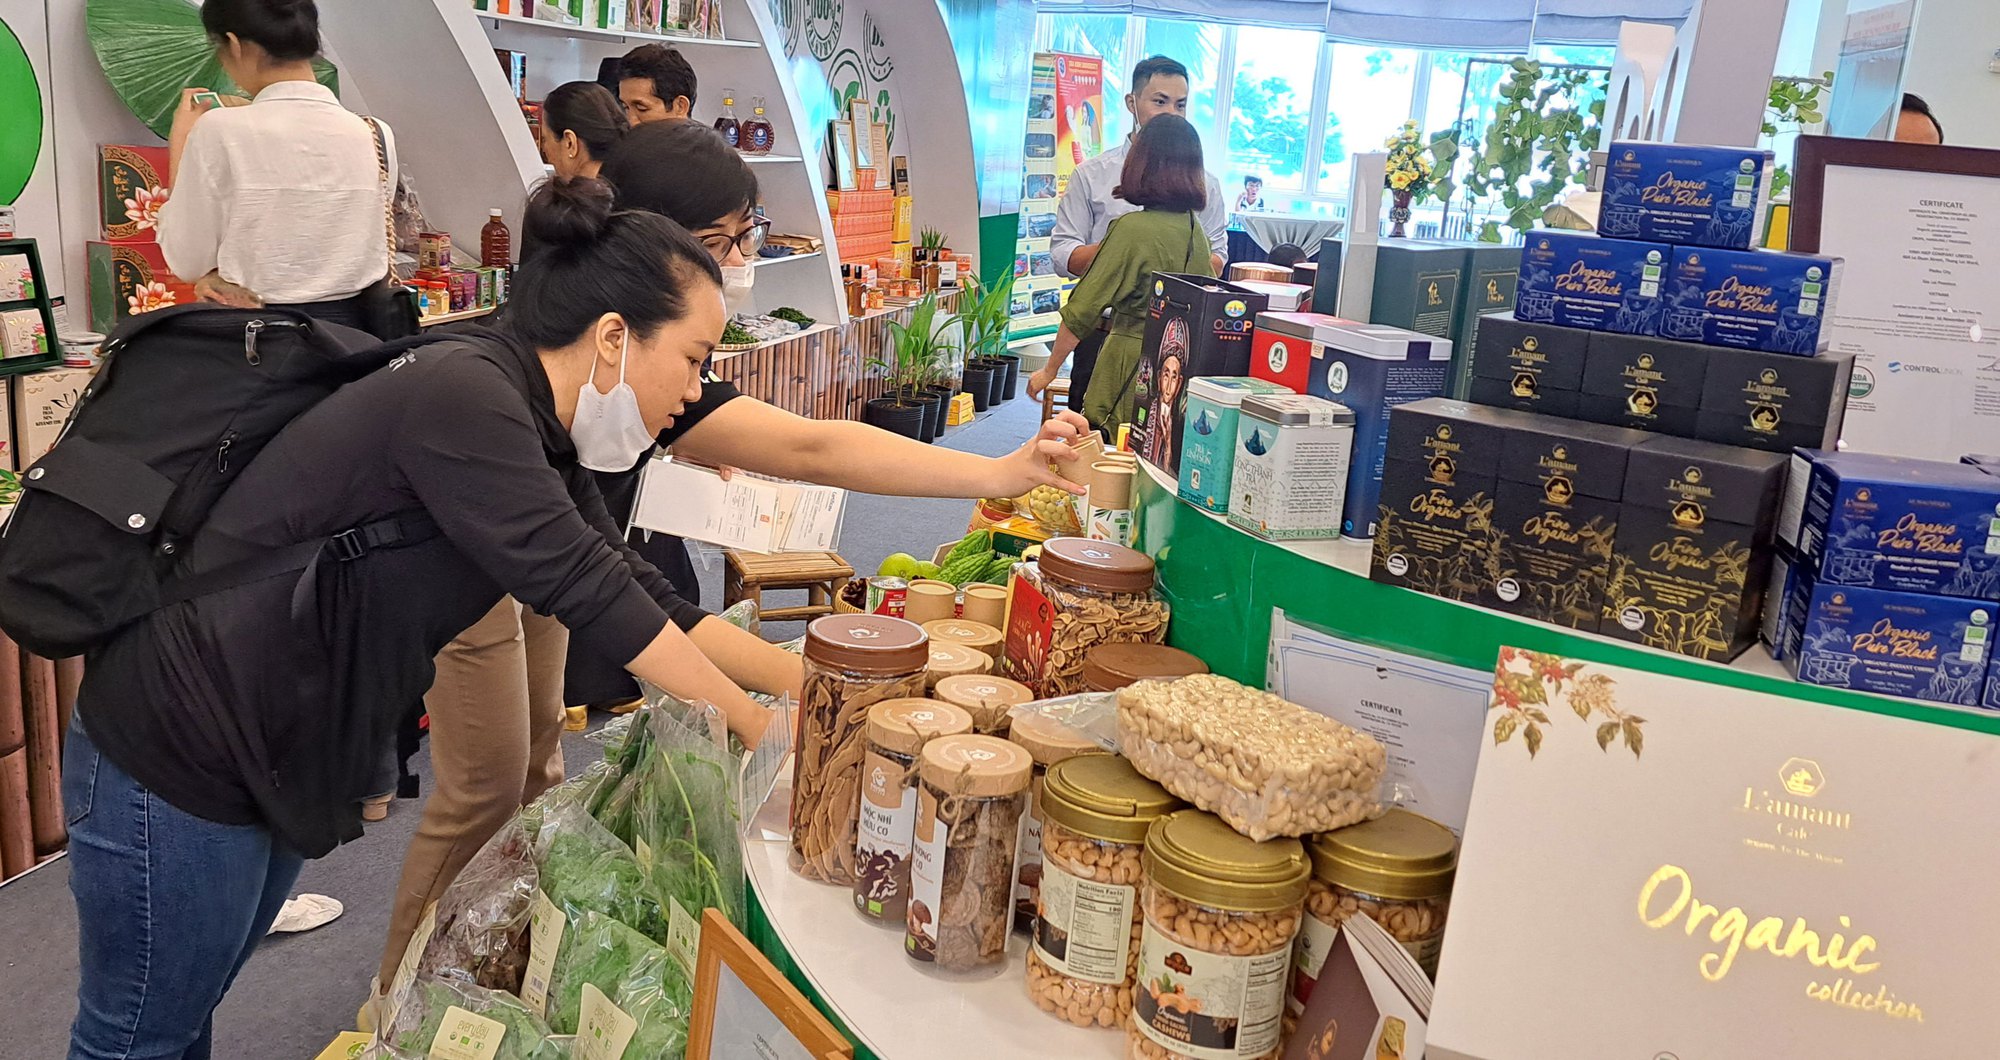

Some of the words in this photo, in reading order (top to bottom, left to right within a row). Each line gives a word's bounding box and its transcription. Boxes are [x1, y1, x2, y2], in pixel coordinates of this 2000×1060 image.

[1657, 171, 1707, 194] Organic
[1642, 186, 1670, 203] Pure
[1673, 190, 1712, 207] Black
[1920, 200, 1963, 209] CERTIFICATE
[1570, 260, 1616, 282] Organic
[1555, 274, 1583, 291] Pure
[1585, 279, 1622, 295] Black
[1721, 276, 1772, 299] Organic
[1705, 290, 1735, 308] Pure
[1738, 295, 1778, 314] Black
[1214, 319, 1252, 332] OCOP
[1904, 364, 1940, 373] CONTROL
[1425, 436, 1460, 451] L'amant
[1539, 455, 1578, 472] L'amant
[1669, 478, 1712, 494] L'amant
[1410, 494, 1462, 521] Organic
[1429, 488, 1454, 508] Fine
[1523, 516, 1579, 544] Organic
[1543, 511, 1570, 531] Fine
[1896, 513, 1956, 539] Organic
[1672, 536, 1702, 556] Fine
[1877, 528, 1913, 550] Pure
[1916, 535, 1963, 554] Black
[1650, 542, 1710, 571] Organic
[1871, 618, 1931, 644] Organic
[1852, 633, 1888, 654] Pure
[1891, 641, 1937, 660] Black
[1360, 699, 1402, 716] CERTIFICATE
[1744, 787, 1850, 829] L'amant
[1638, 863, 1880, 981] Organic
[1806, 978, 1924, 1023] collection
[1152, 1019, 1191, 1042] CASHEWS
